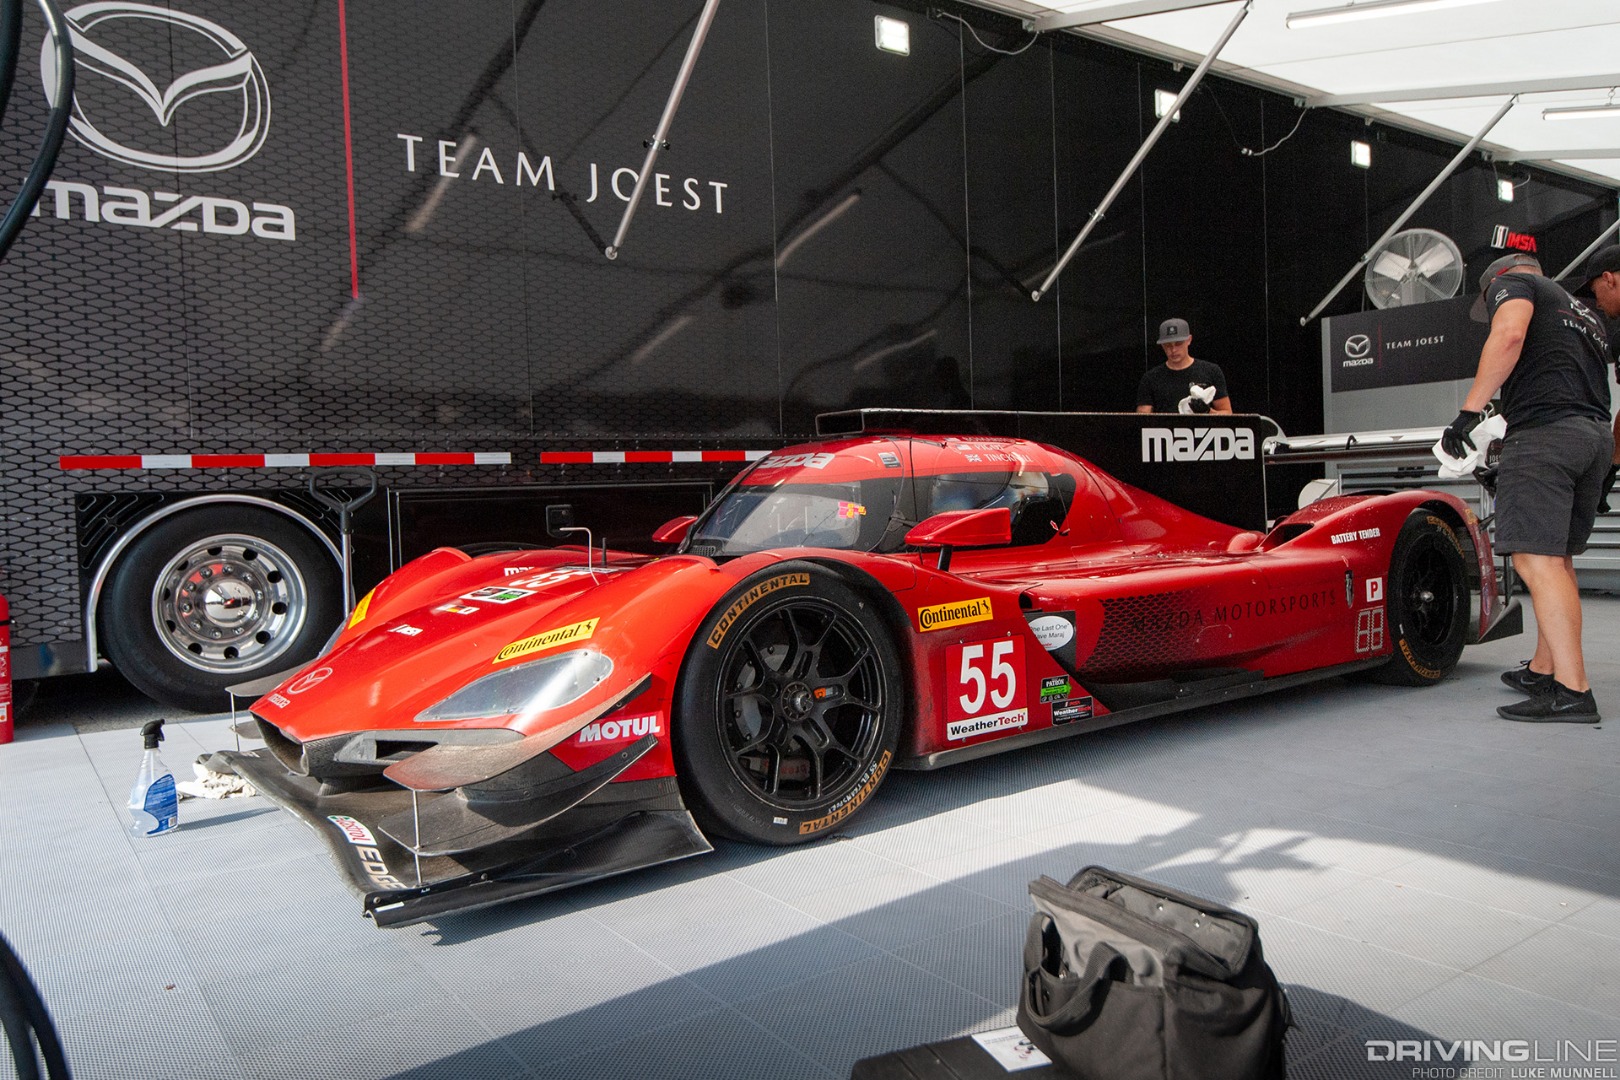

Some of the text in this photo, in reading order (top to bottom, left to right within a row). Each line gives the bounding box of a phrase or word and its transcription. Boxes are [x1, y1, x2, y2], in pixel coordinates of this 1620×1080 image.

[397, 133, 728, 214] TEAM JOEST
[1506, 231, 1537, 253] IMSA
[1386, 335, 1445, 350] TEAM JOEST
[1141, 427, 1255, 463] mazda
[1330, 527, 1381, 545] BATTERY TENDER
[1213, 589, 1337, 623] MOTORSPORTS
[1370, 581, 1379, 599] P
[711, 573, 809, 646] CONTINENTAL
[919, 600, 982, 629] Continental
[497, 621, 583, 661] Continental
[959, 640, 1017, 715] 55
[579, 714, 661, 744] MOTUL
[950, 712, 1026, 736] WeatherTech
[803, 753, 889, 832] CONTINENTAL
